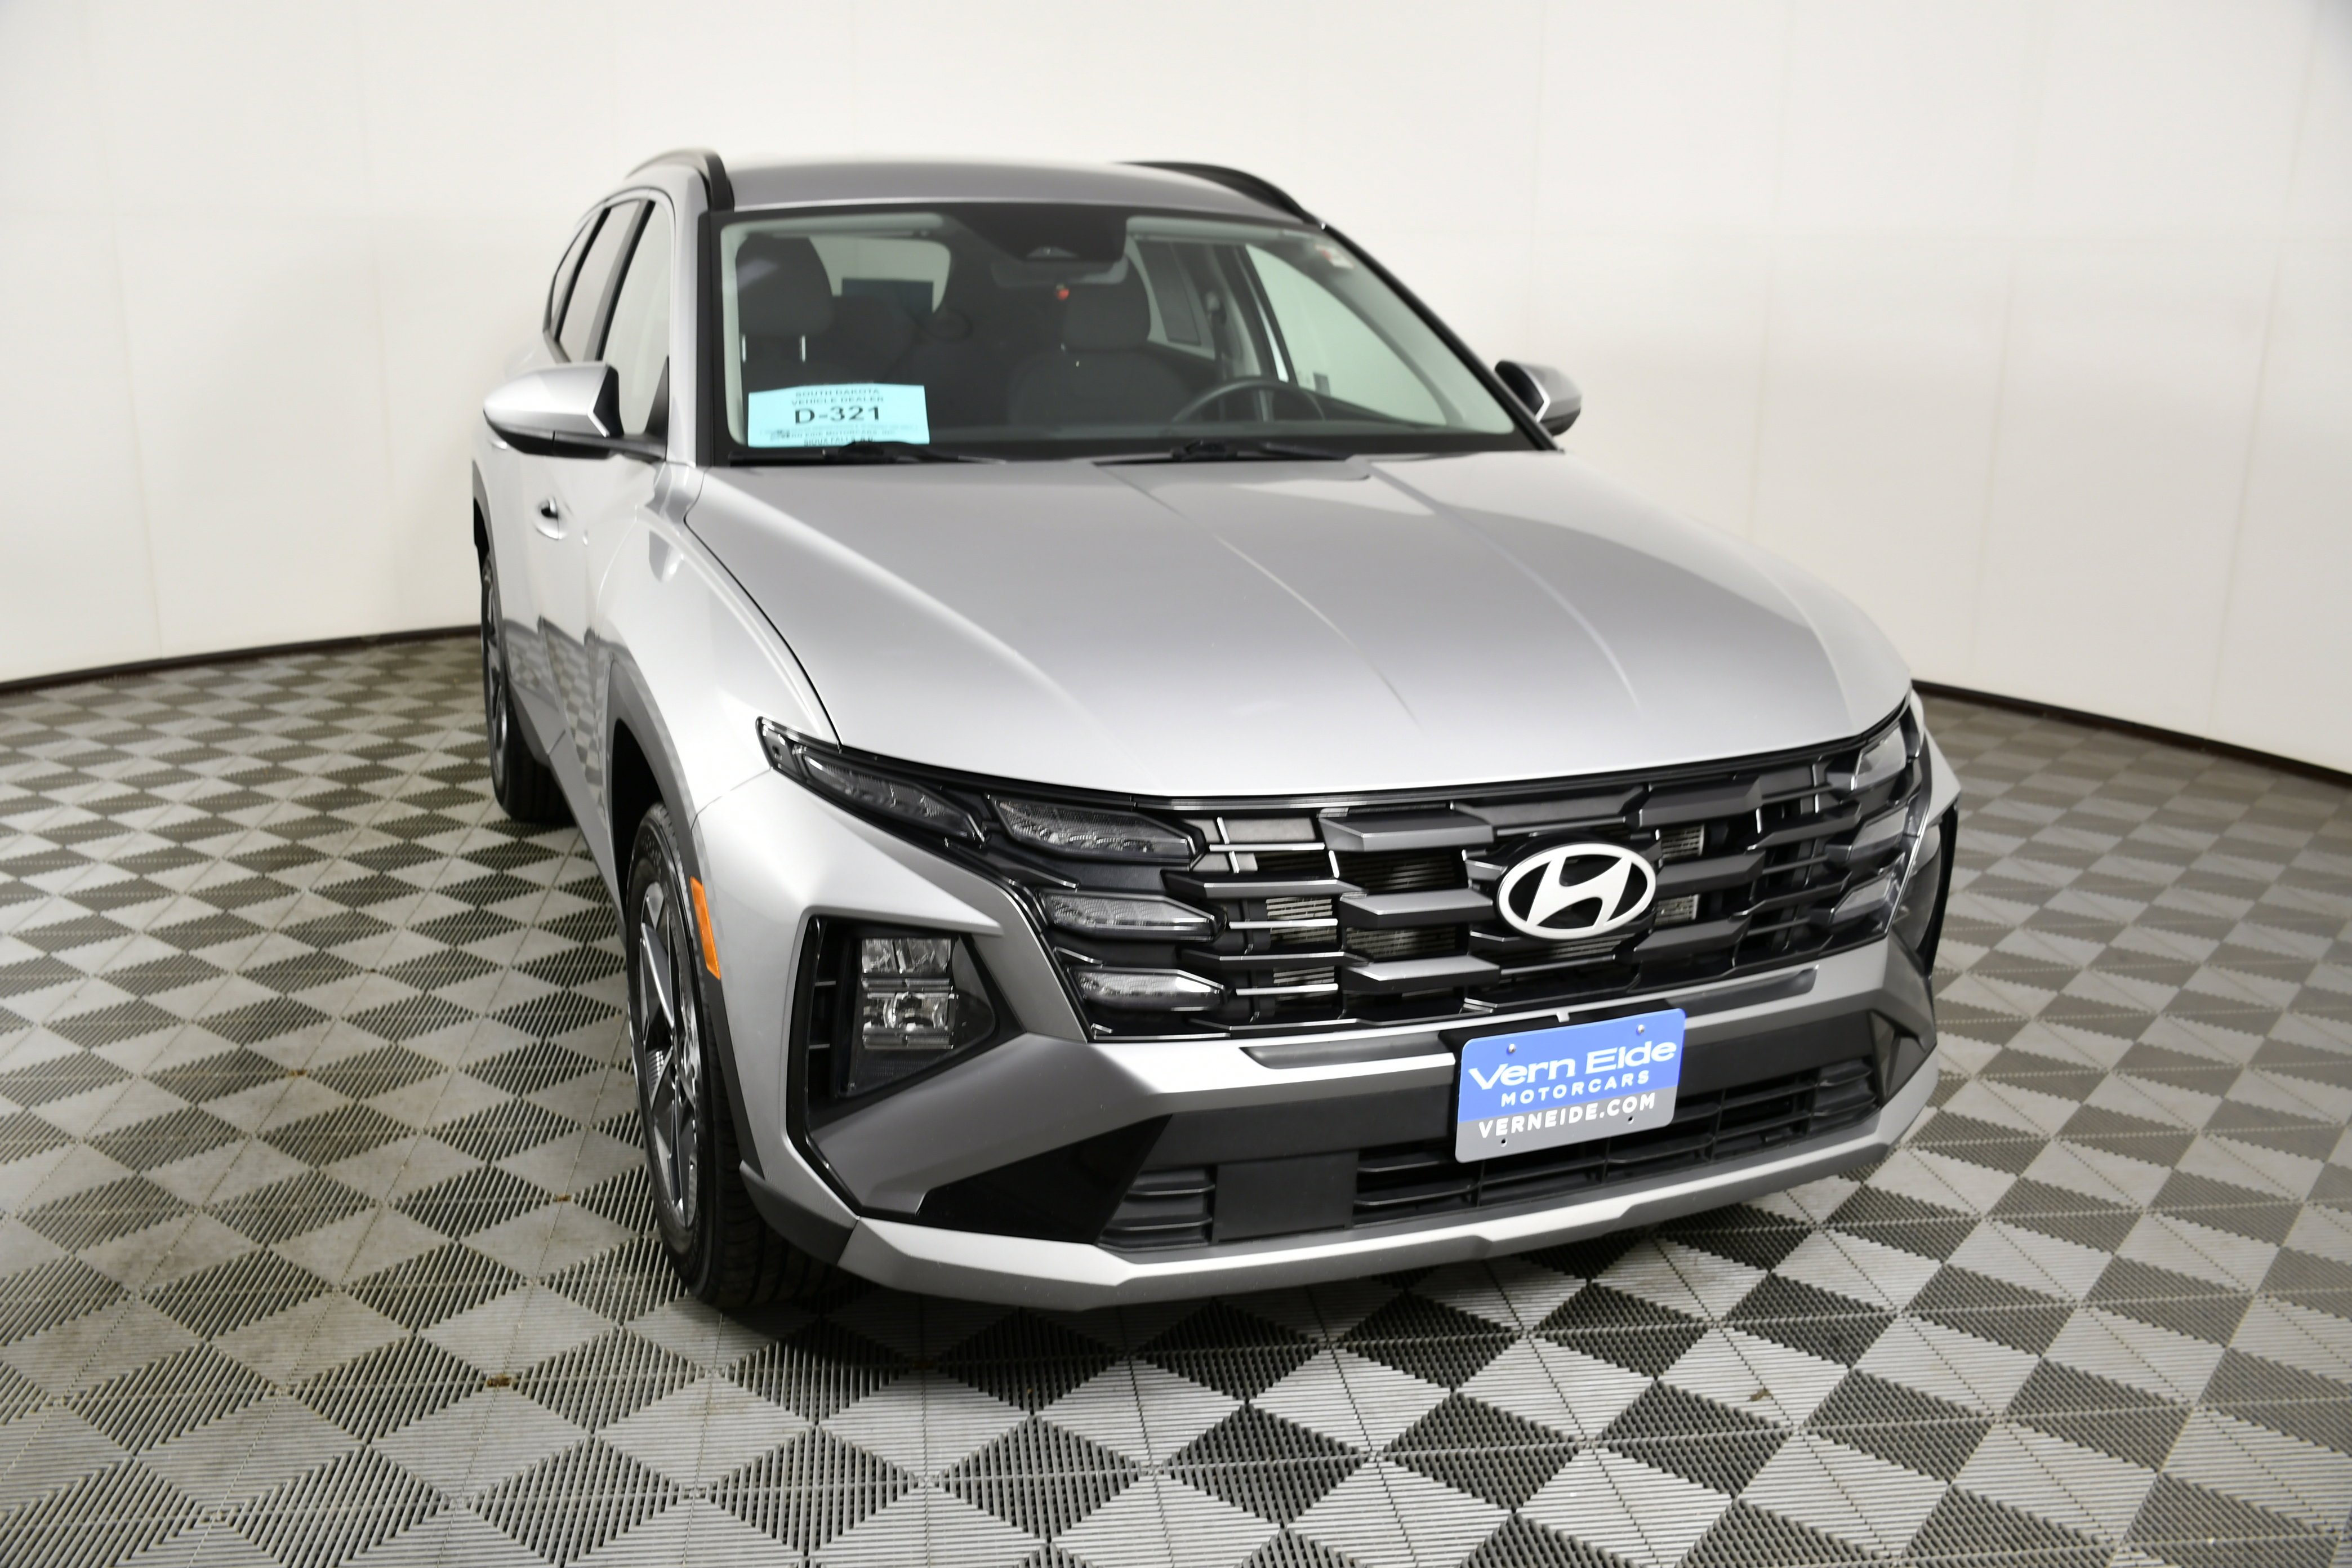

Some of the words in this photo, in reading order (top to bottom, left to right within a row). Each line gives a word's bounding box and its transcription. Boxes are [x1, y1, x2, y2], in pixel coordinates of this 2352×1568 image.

[795, 406, 879, 425] D-321
[1468, 1057, 1576, 1090] Vern
[1501, 1070, 1650, 1107] MOTORCARS
[1478, 1093, 1656, 1138] VERNEIDE.COM
